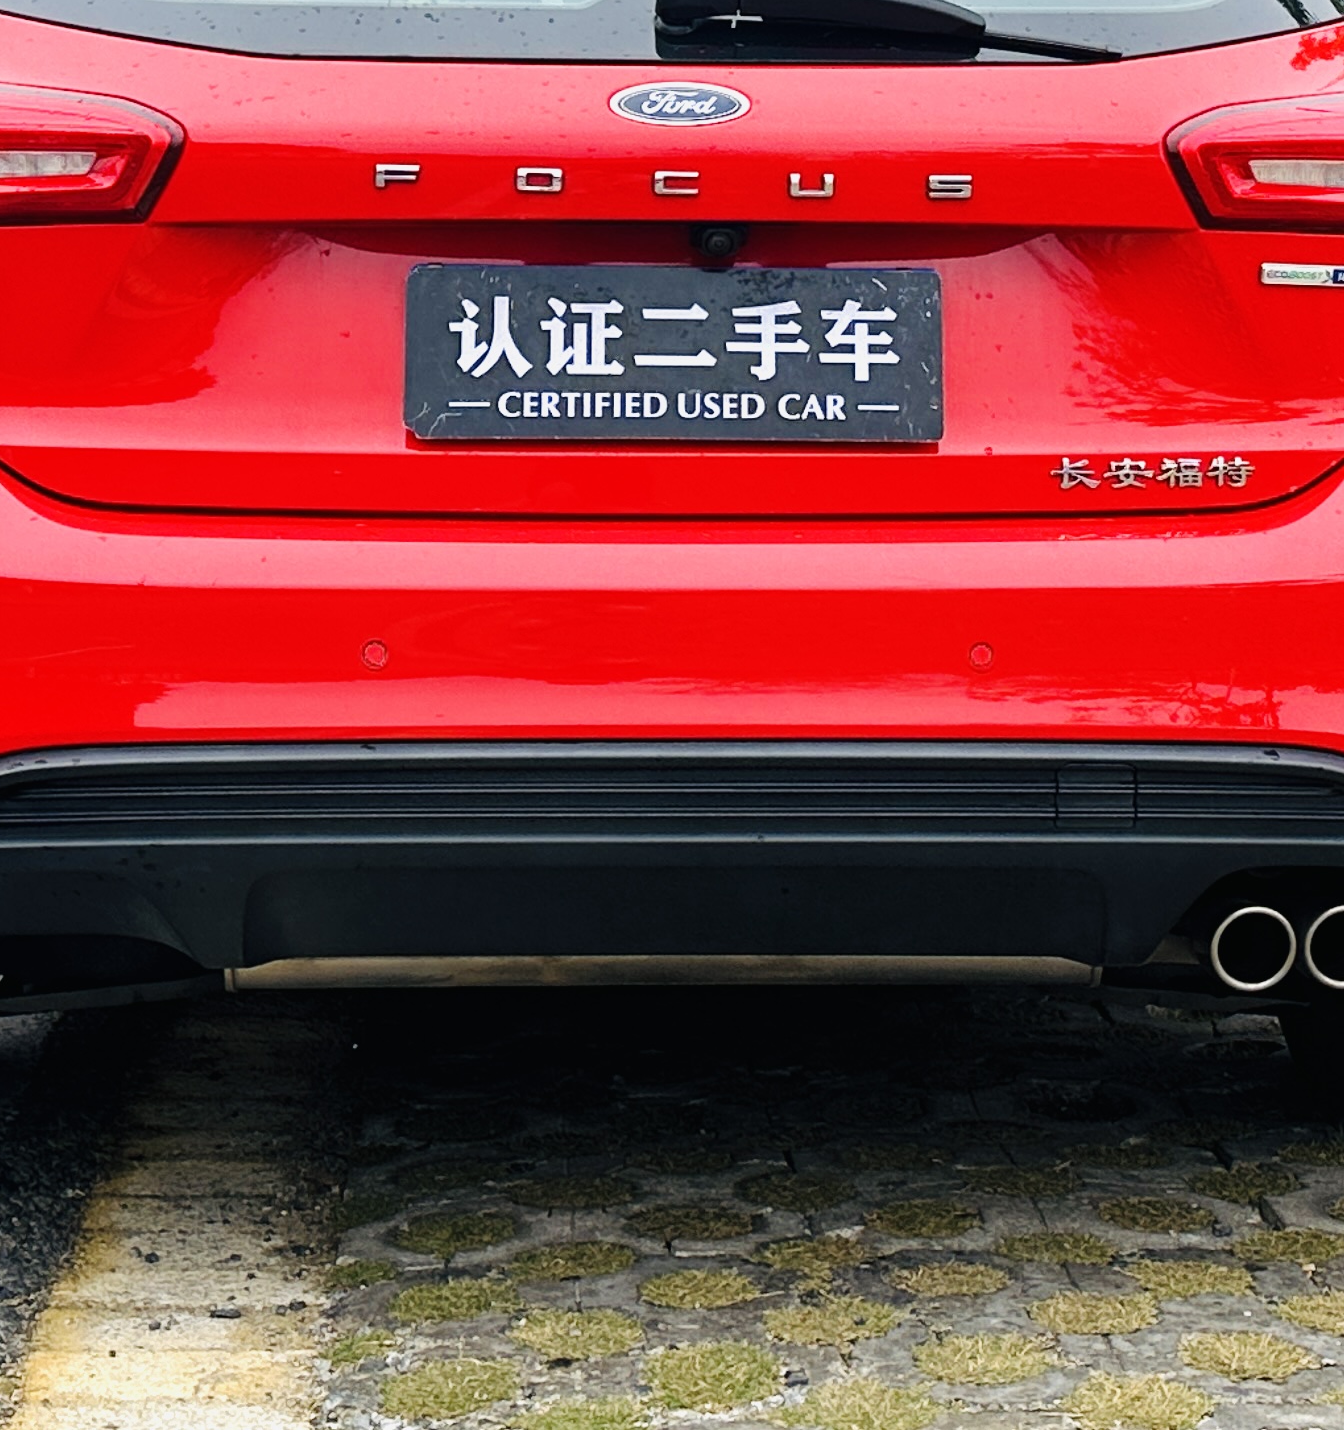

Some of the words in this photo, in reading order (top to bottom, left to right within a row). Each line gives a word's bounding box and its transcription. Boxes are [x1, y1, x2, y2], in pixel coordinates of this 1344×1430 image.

[641, 90, 718, 115] Ford
[374, 164, 973, 199] FOCUS
[448, 296, 901, 382] 认证二手车
[497, 391, 669, 419] CERTIFIED
[676, 392, 767, 420] USED
[778, 393, 847, 421] CAR
[1050, 455, 1256, 489] 长安福特
